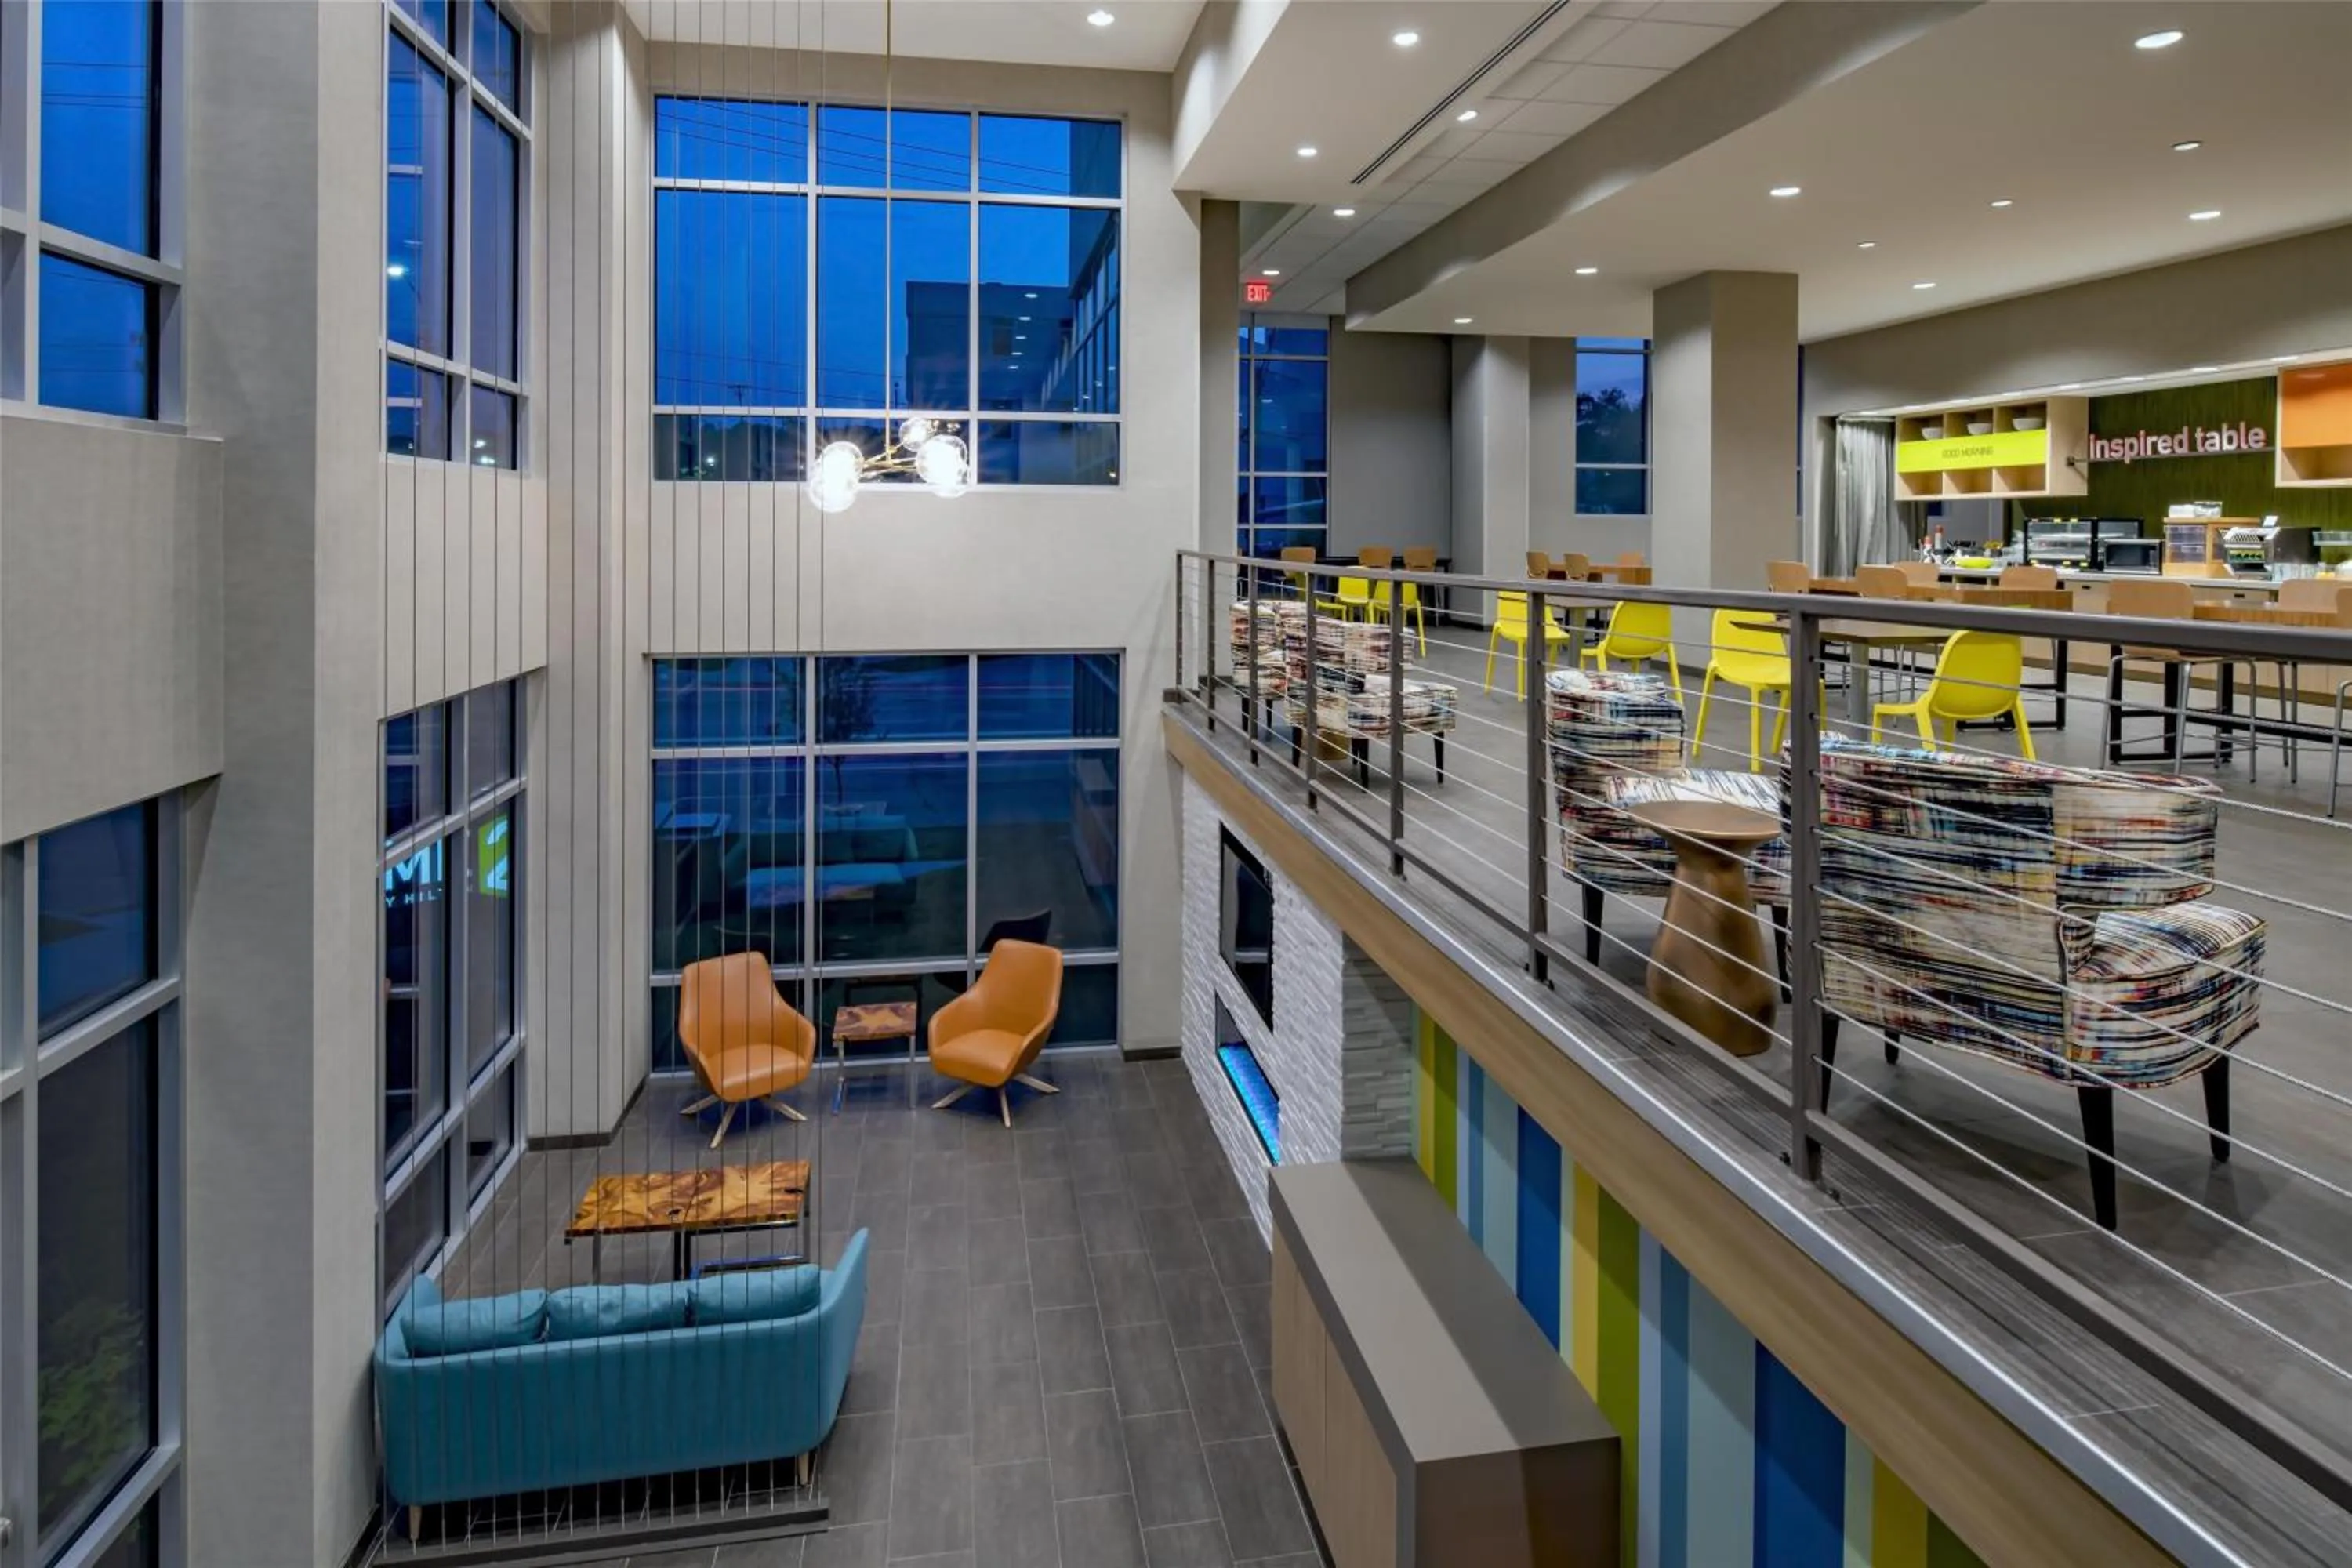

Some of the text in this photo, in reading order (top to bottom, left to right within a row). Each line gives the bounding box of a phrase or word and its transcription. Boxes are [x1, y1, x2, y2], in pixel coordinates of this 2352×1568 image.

[1247, 285, 1268, 302] EXIT
[2089, 421, 2267, 464] inspired table
